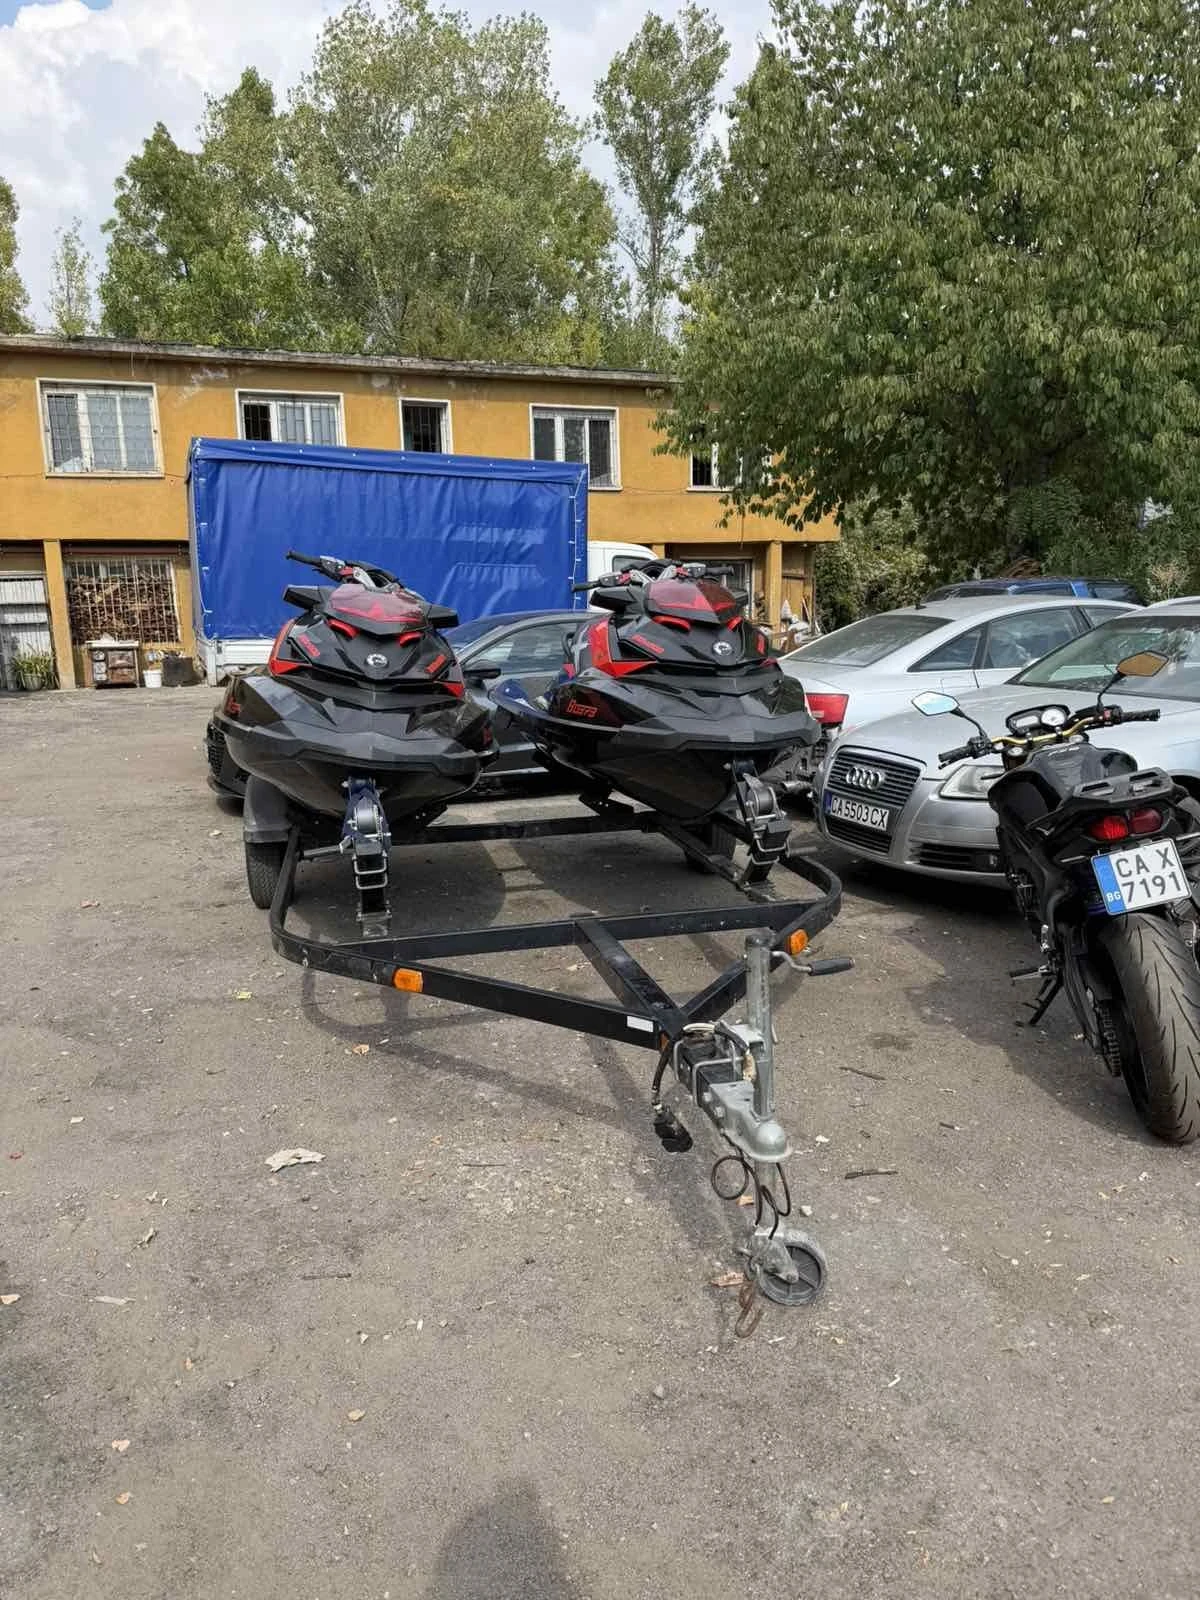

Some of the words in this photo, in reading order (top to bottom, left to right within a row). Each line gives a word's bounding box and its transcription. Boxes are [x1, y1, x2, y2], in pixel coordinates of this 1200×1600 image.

[831, 797, 843, 815] CA
[844, 801, 870, 822] 5503
[871, 808, 888, 828] CX
[1115, 854, 1150, 878] CA
[1156, 847, 1175, 869] X
[1106, 891, 1121, 902] BG
[1122, 871, 1181, 903] 7191
